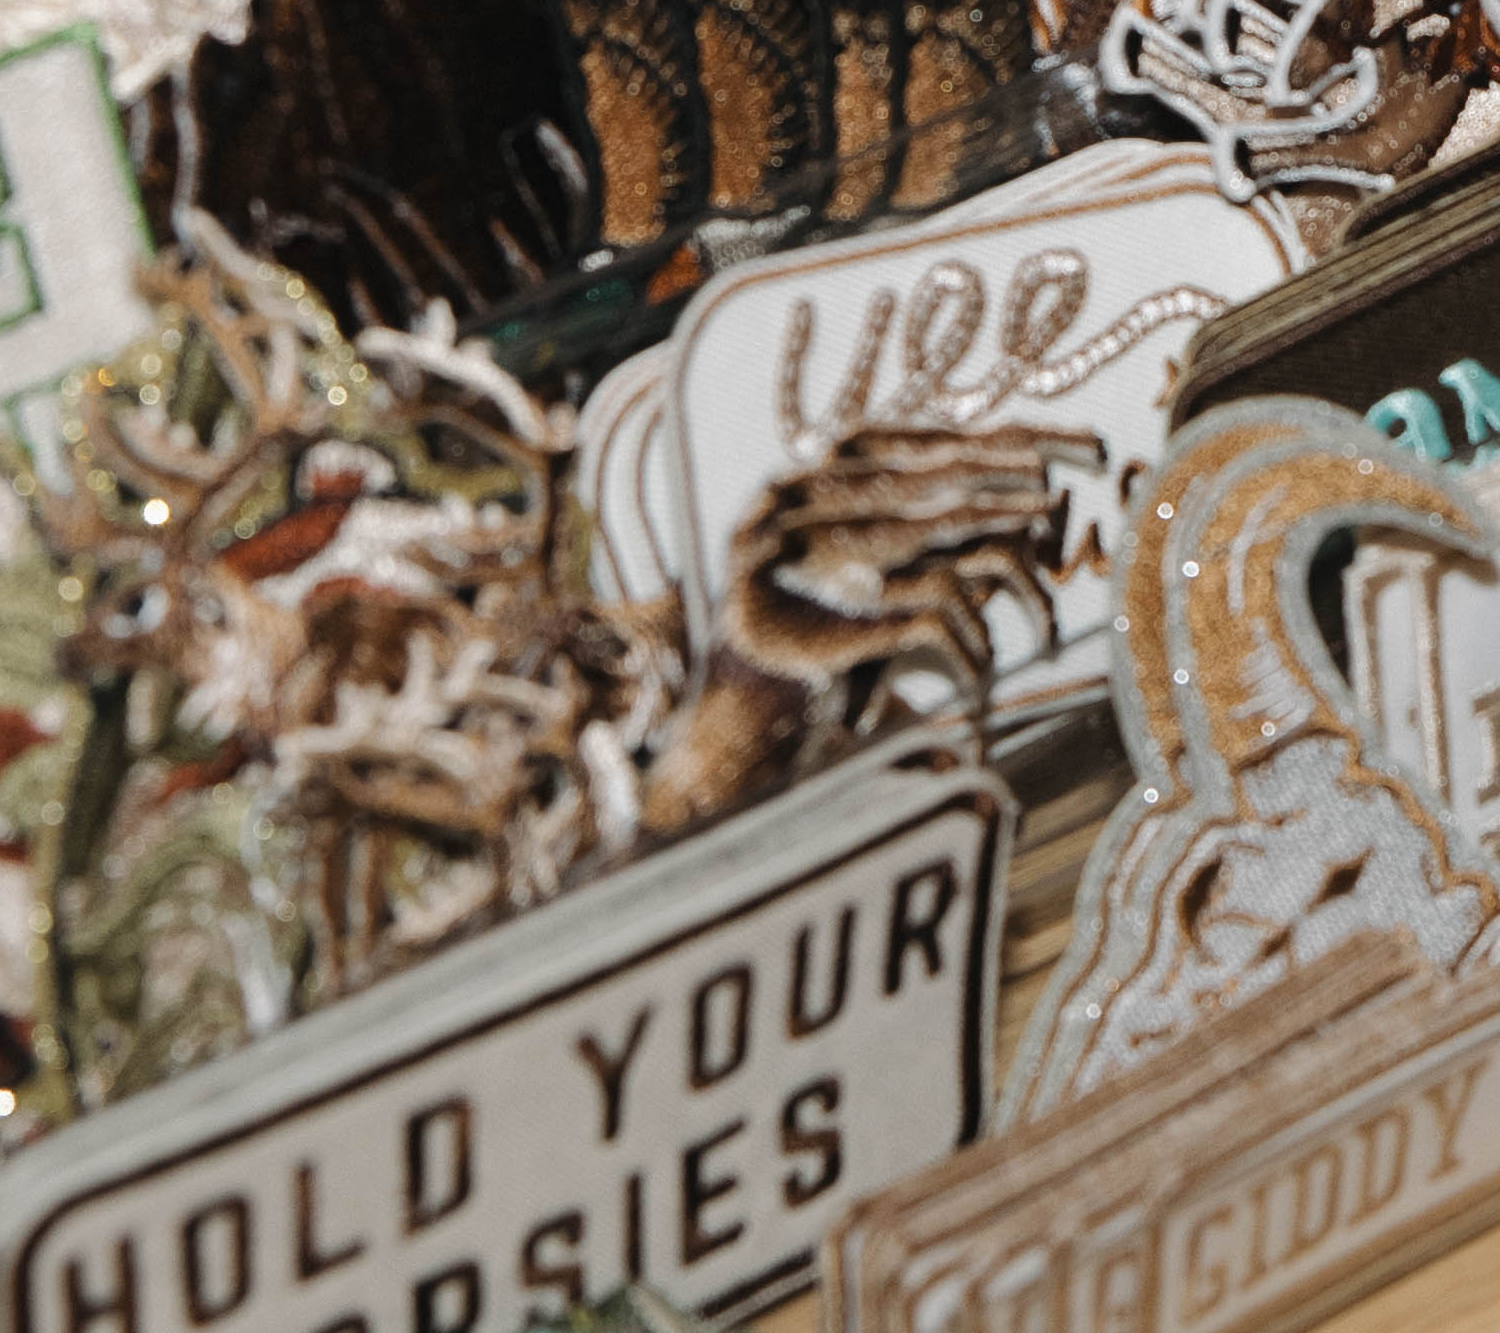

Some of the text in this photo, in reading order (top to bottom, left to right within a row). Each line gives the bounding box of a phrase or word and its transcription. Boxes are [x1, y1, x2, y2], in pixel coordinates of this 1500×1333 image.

[59, 856, 961, 1333] HOLD YOUR
[1183, 1049, 1490, 1320] GIDDY
